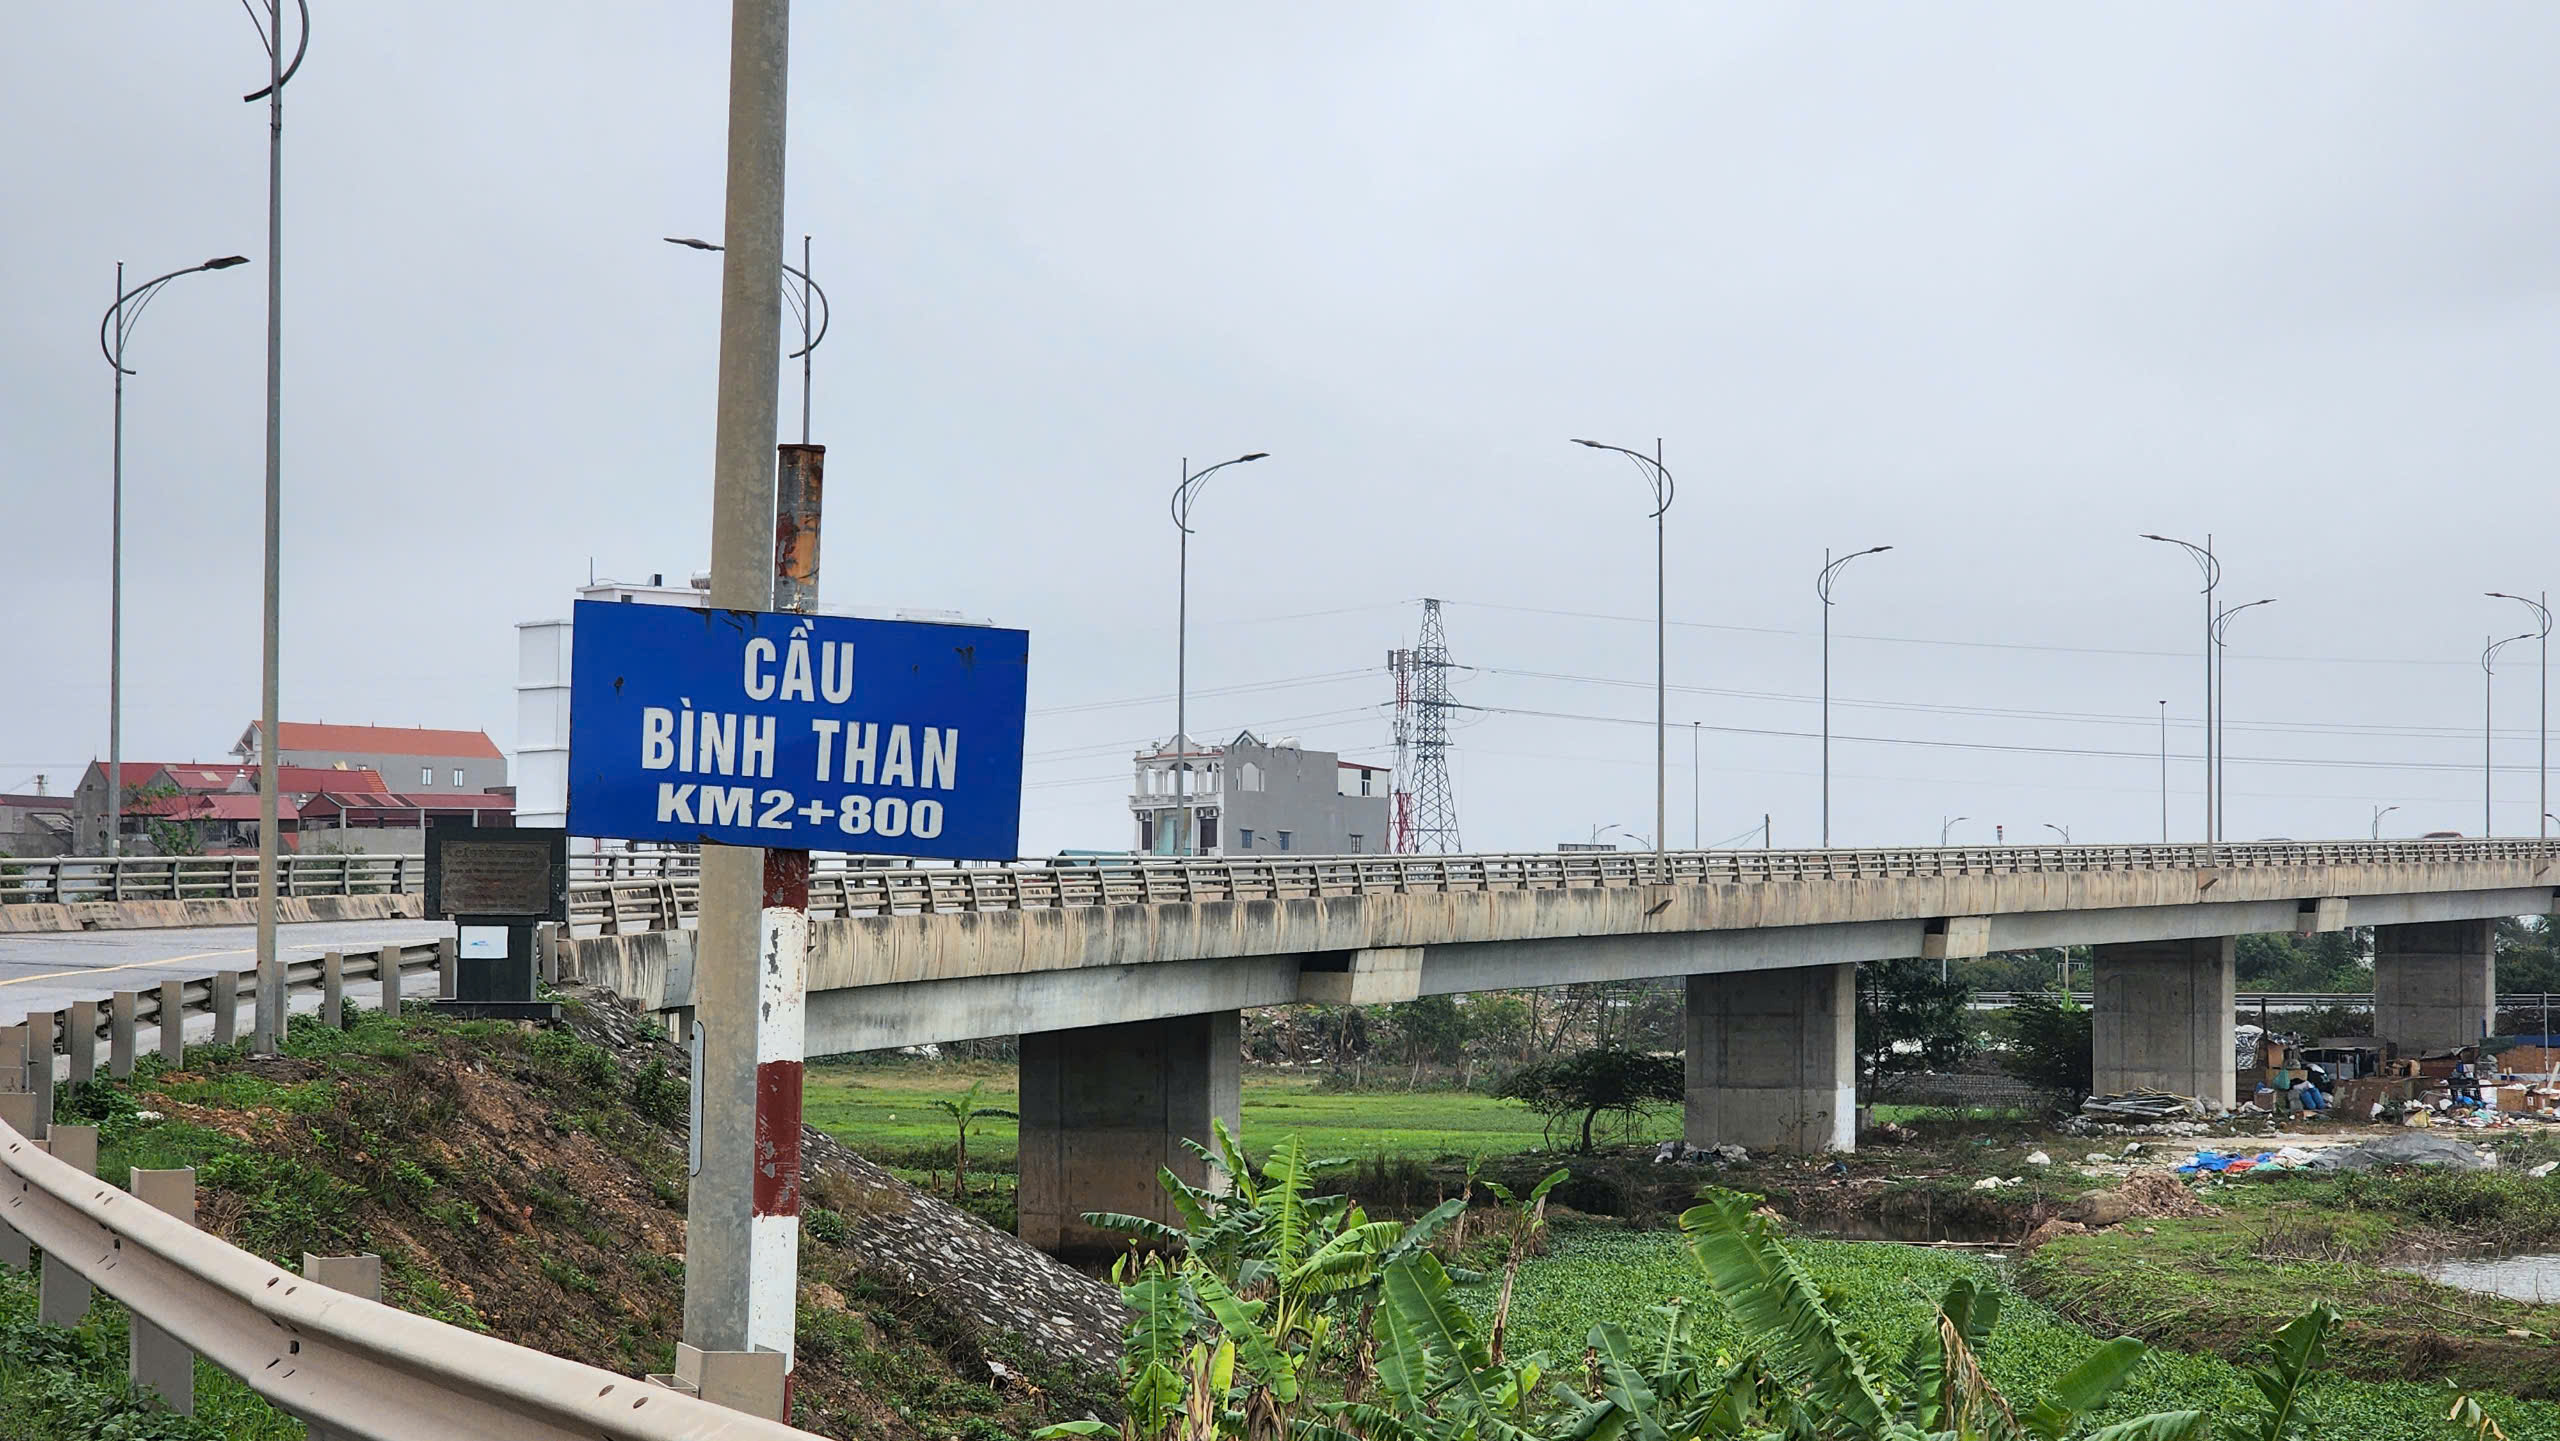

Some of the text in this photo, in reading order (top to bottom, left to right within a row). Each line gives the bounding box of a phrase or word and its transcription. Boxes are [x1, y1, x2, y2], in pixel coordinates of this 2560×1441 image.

[743, 618, 855, 704] CẦU
[641, 697, 959, 791] BÌNH THAN
[656, 782, 944, 839] KM2+800
